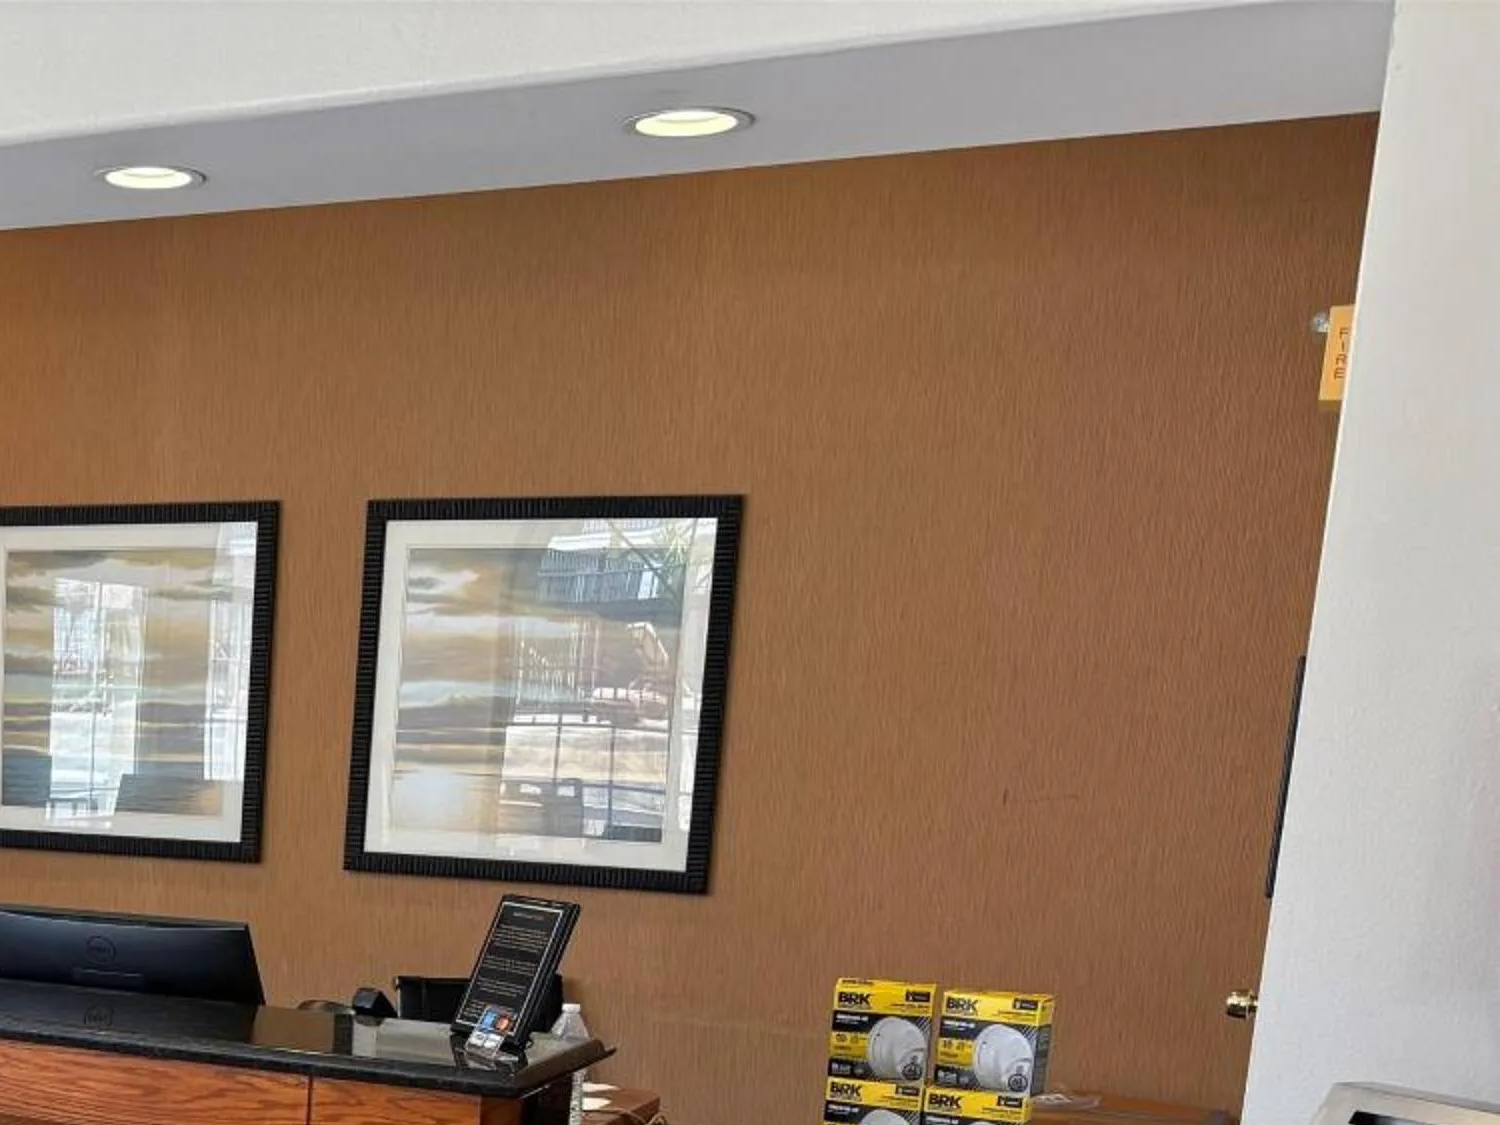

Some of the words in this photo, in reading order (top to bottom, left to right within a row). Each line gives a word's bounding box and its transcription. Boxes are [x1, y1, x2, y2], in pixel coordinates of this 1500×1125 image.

[838, 991, 871, 1006] BRK
[946, 996, 979, 1014] BRK
[830, 1081, 862, 1098] BRK
[928, 1092, 962, 1109] BRK
